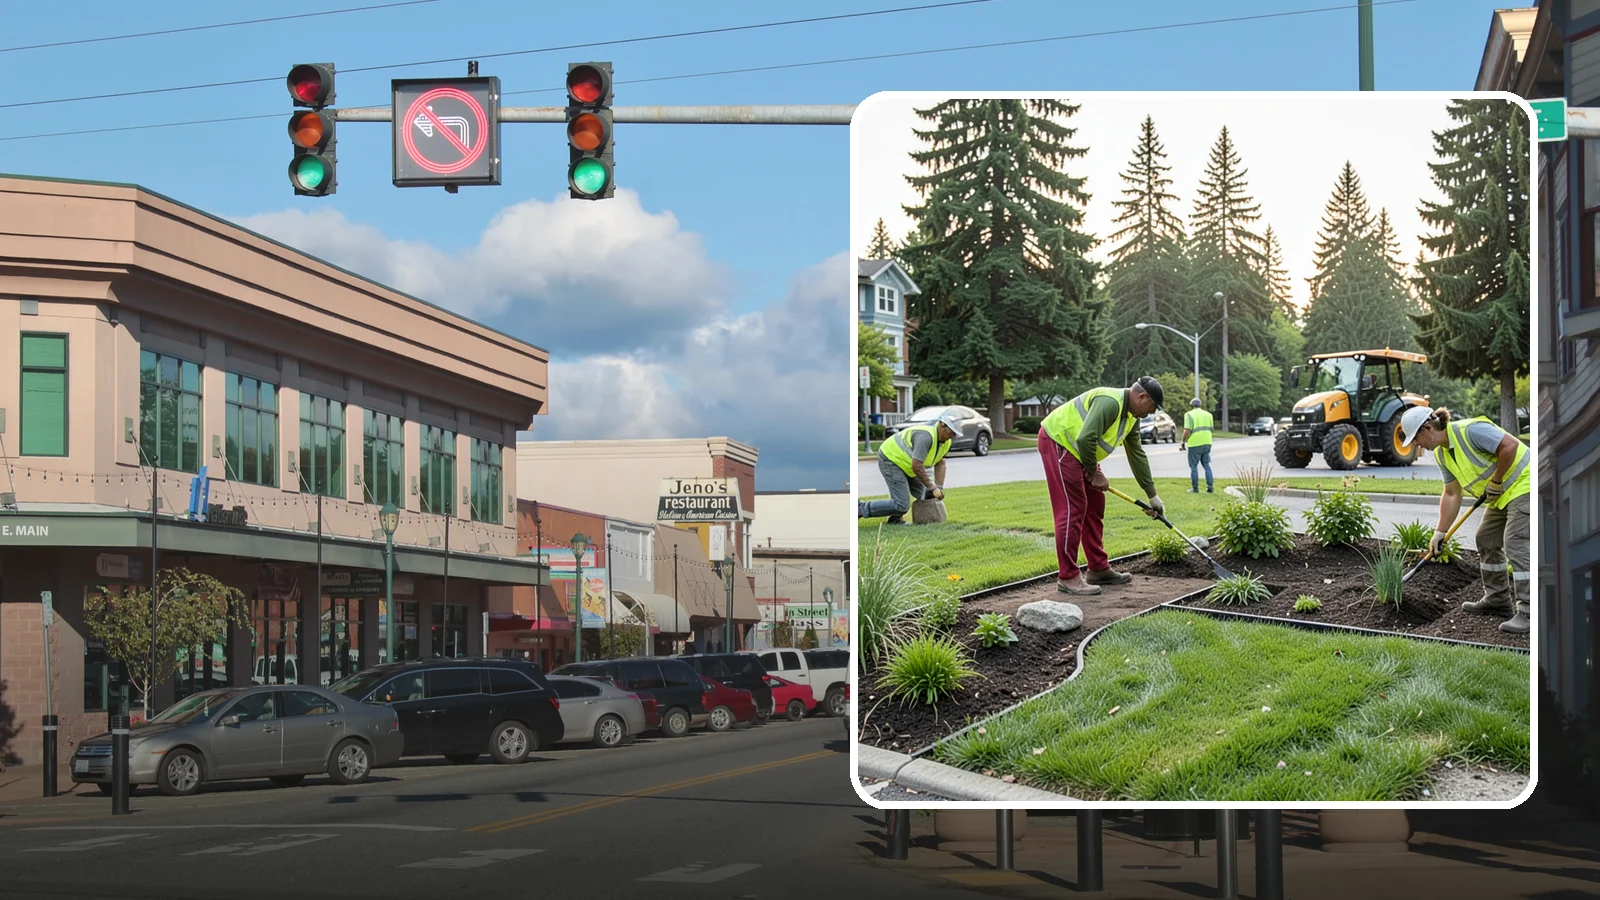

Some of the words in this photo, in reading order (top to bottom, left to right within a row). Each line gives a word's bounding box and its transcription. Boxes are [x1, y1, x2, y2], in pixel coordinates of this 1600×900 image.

[670, 480, 727, 494] Jeno's
[665, 496, 731, 509] restaurant
[658, 510, 681, 519] Italian
[686, 510, 714, 519] American
[715, 509, 737, 519] Cuisine
[2, 525, 13, 536] E.
[15, 525, 49, 536] MAIN
[797, 607, 829, 617] Street
[790, 619, 824, 627] lass
